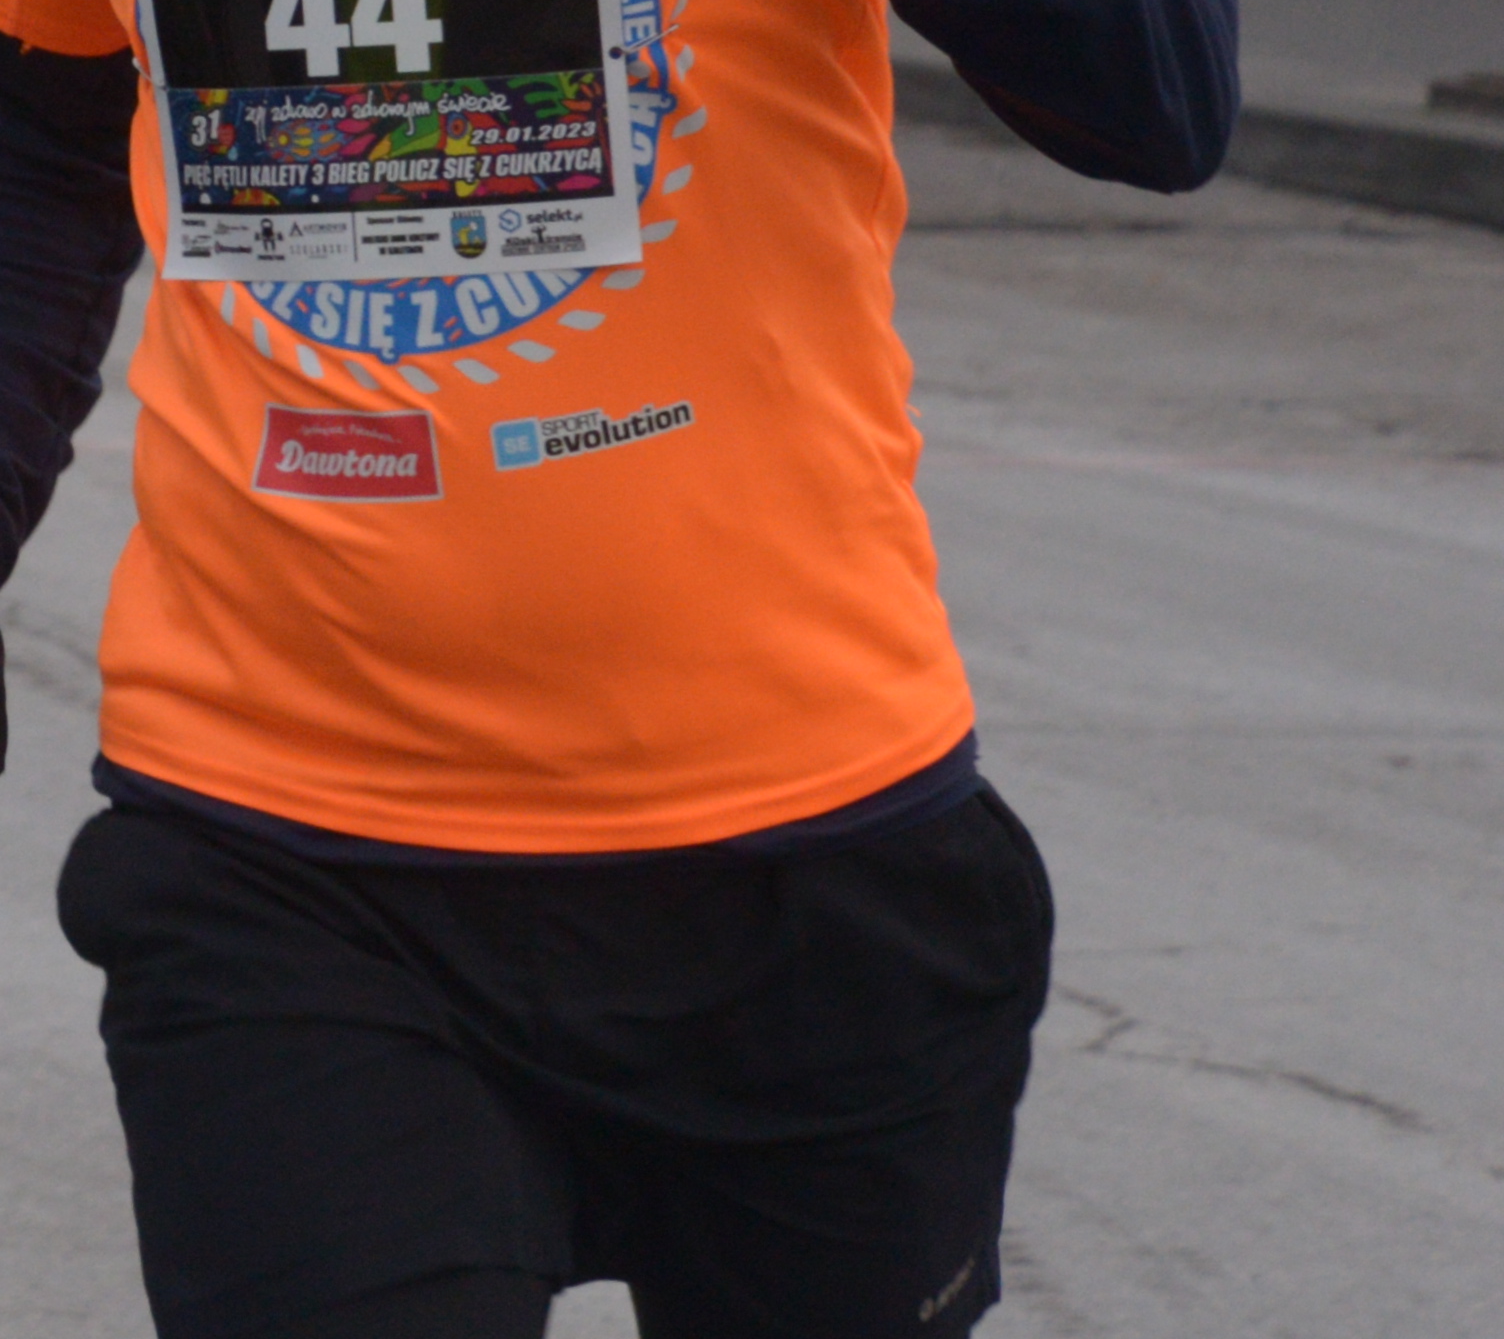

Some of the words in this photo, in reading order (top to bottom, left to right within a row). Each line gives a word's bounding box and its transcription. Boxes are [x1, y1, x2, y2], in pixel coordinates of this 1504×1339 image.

[190, 109, 222, 147] 31
[470, 122, 597, 145] 29.01.2023
[251, 163, 309, 186] KALETY
[312, 164, 324, 185] 3
[328, 161, 370, 184] BIEG
[374, 158, 440, 183] POLICZ
[443, 156, 475, 183] SIĘ
[479, 155, 491, 177] Z
[495, 147, 603, 175] CUKRZYCĄ
[309, 281, 394, 360] SIĘ
[410, 289, 444, 348] Z
[541, 411, 601, 437] SPORT
[544, 403, 691, 457] evolution
[275, 438, 419, 478] Dawtona
[503, 435, 531, 454] SE
